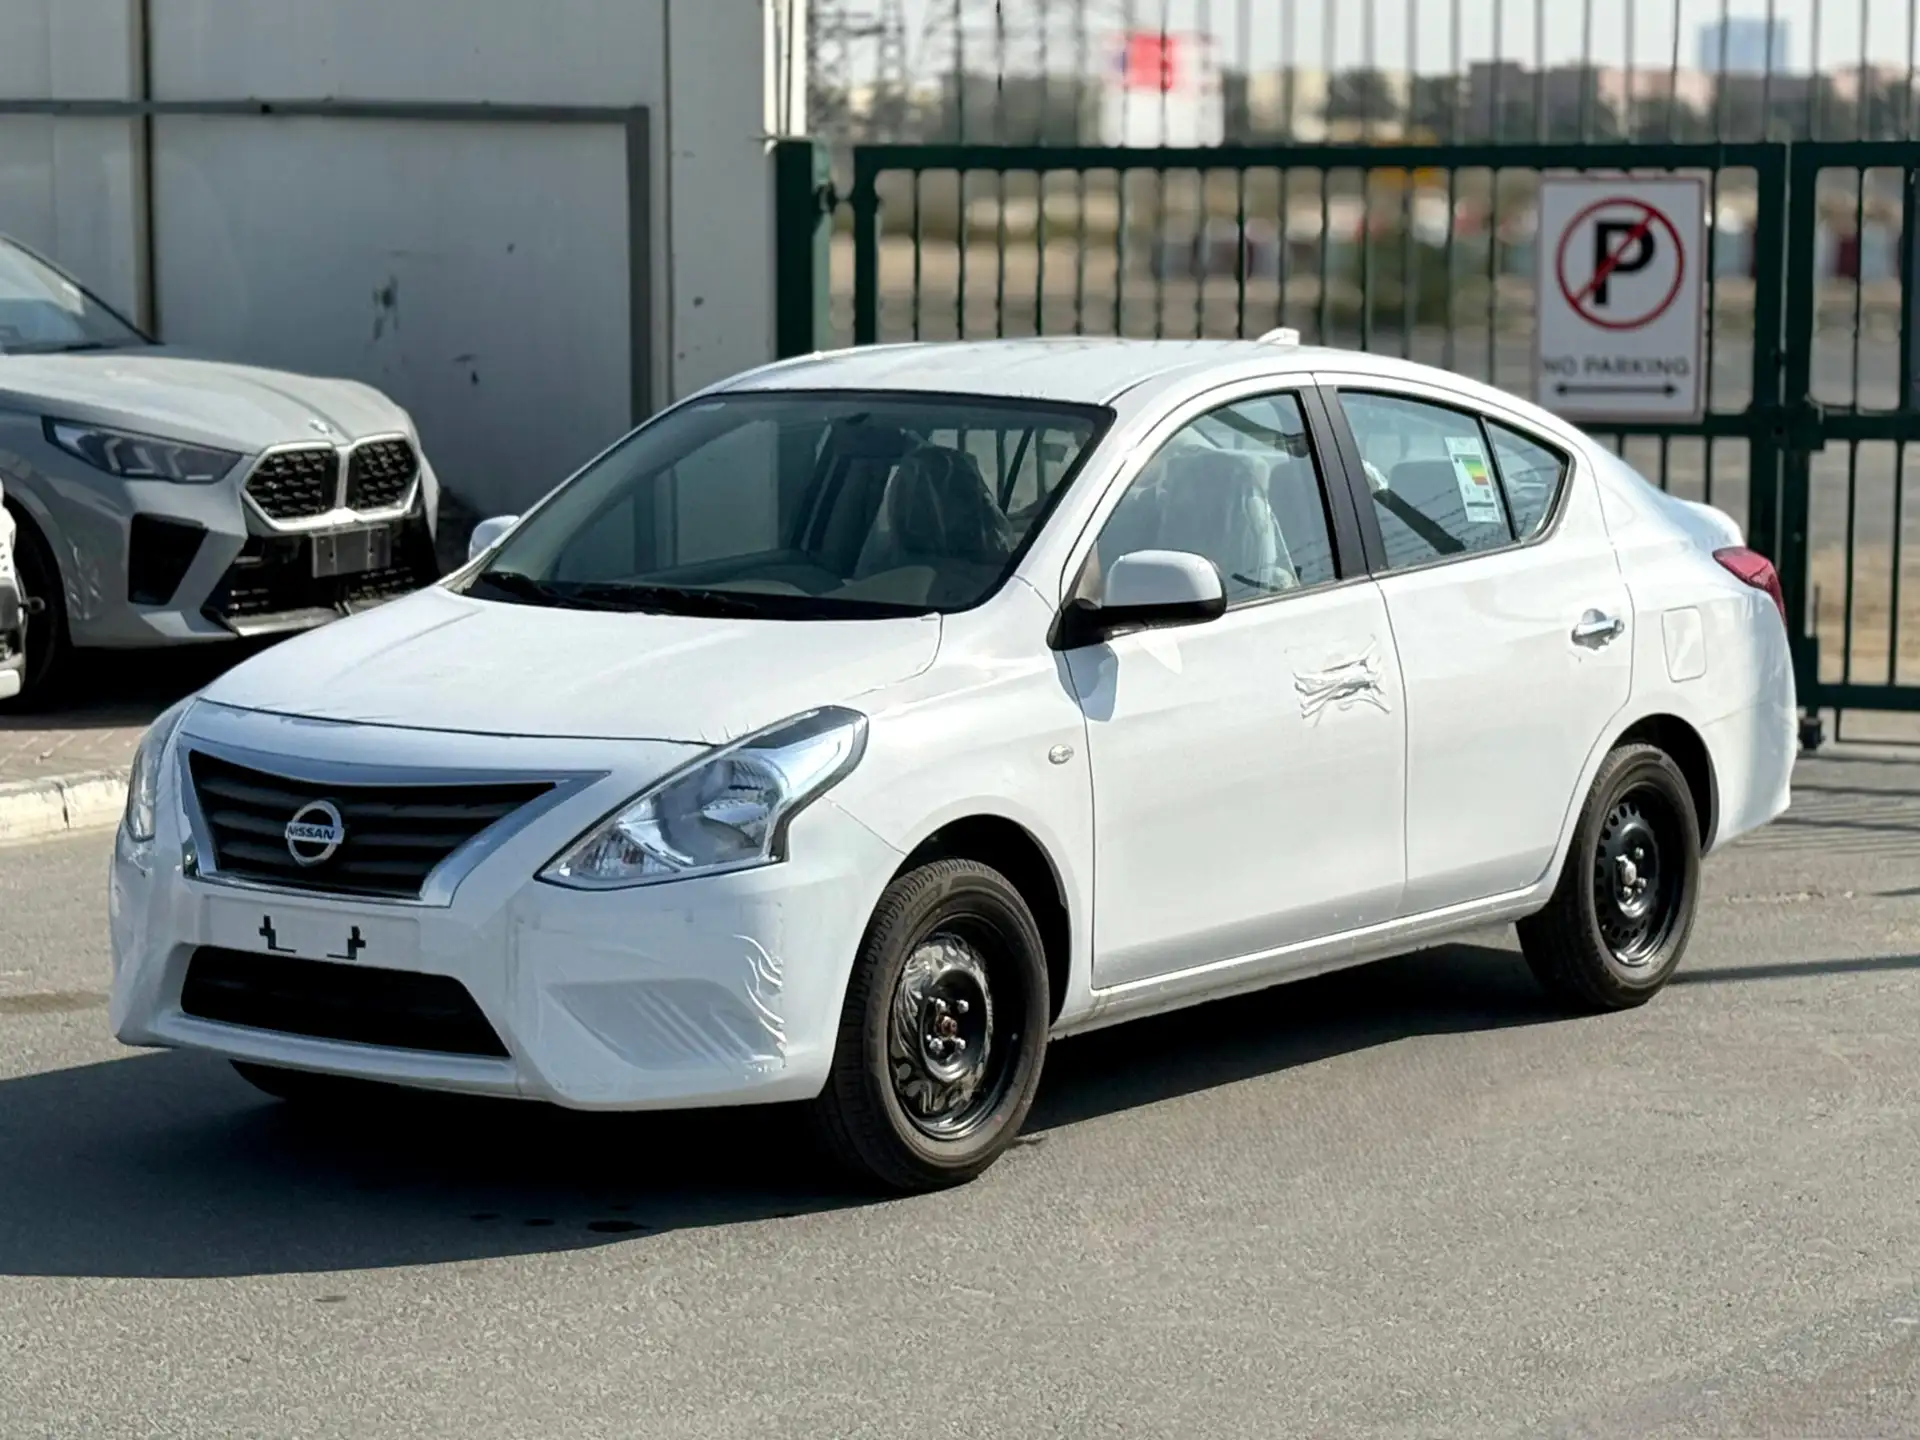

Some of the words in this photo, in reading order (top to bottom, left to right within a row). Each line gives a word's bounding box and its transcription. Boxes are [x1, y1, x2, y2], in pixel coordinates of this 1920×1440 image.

[1593, 221, 1656, 305] P
[1543, 356, 1577, 376] NO
[1584, 356, 1690, 377] PARKING
[287, 825, 336, 841] NISSAN
